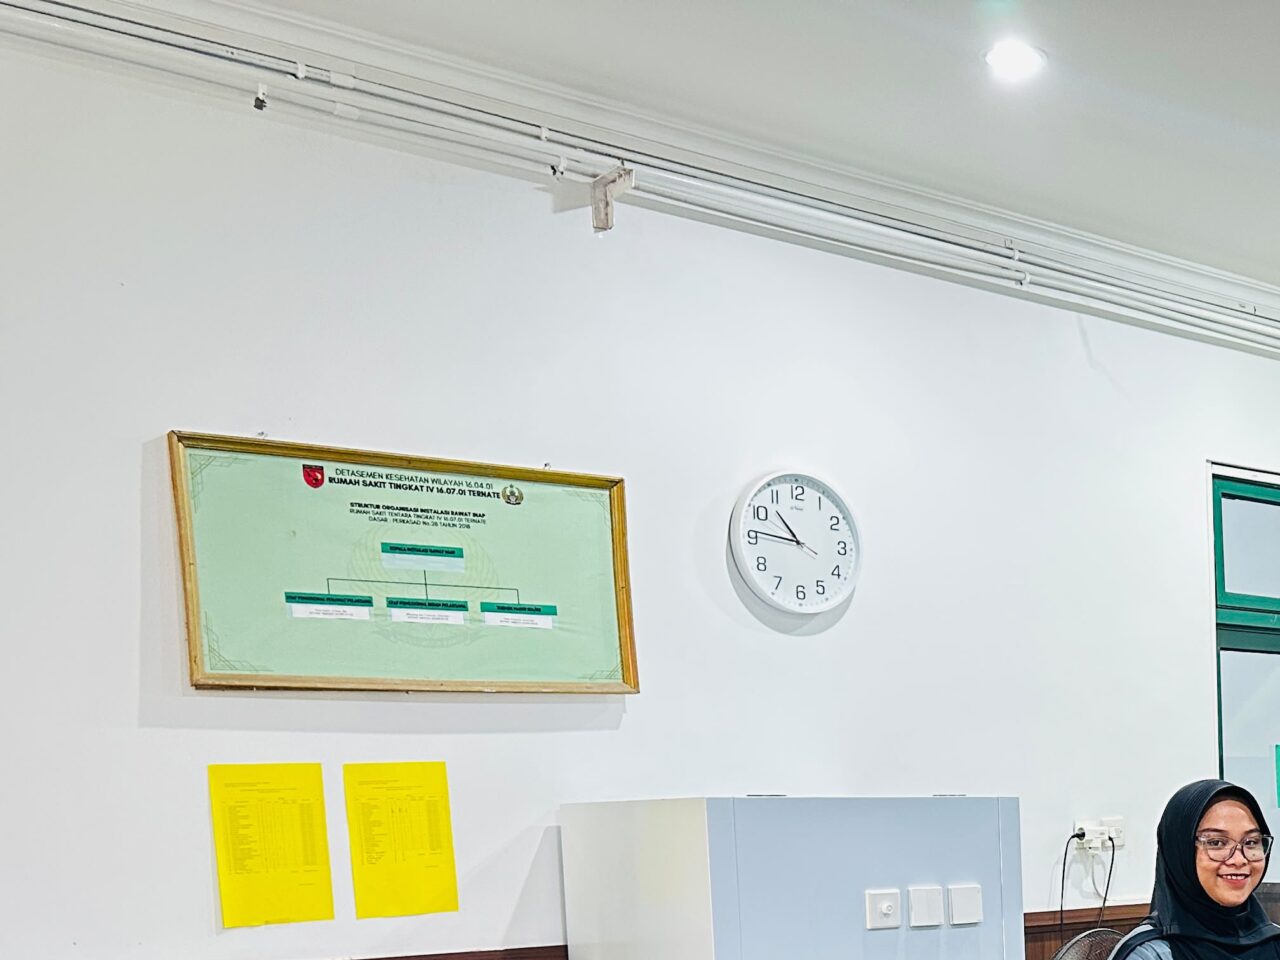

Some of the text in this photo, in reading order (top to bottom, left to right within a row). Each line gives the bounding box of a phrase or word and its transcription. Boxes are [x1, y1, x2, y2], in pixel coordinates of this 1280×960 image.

[335, 468, 493, 490] DETASEMEN KESEHATAN WILAYAH 16.04.01
[328, 476, 360, 486] RUMAH
[362, 480, 386, 489] SAKIT
[389, 482, 424, 492] TINGKAT
[436, 486, 466, 496] 16.07.01
[468, 489, 501, 499] TERNATE
[790, 485, 805, 501] 12
[771, 489, 779, 504] 11
[818, 495, 822, 511] 1
[350, 502, 380, 510] STRUKTUR
[382, 504, 419, 513] ORGANISASI
[420, 508, 449, 516] INSTALASI
[752, 505, 768, 521] 10
[830, 516, 840, 531] 2
[747, 529, 759, 545] 9
[837, 541, 847, 556] 3
[756, 556, 767, 572] 8
[831, 565, 841, 579] 4
[773, 576, 783, 591] 7
[816, 580, 825, 595] 5
[796, 585, 806, 600] 6
